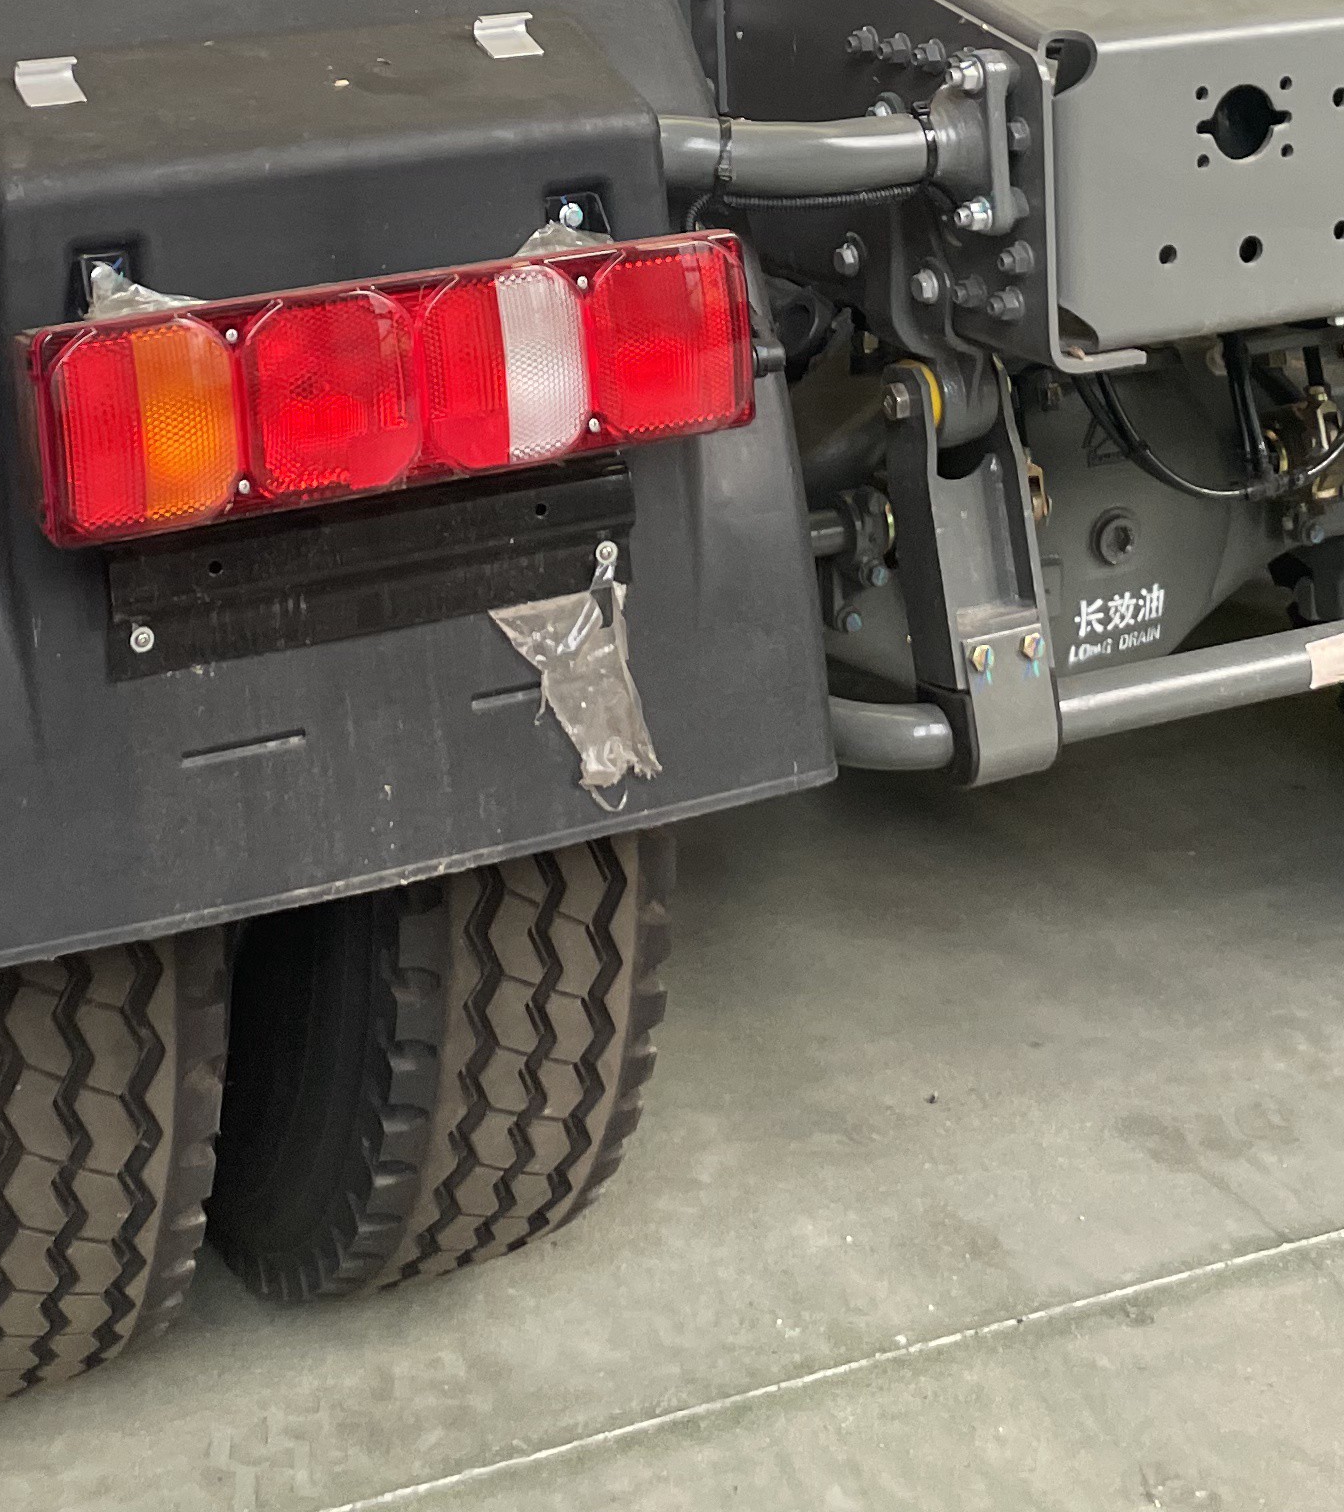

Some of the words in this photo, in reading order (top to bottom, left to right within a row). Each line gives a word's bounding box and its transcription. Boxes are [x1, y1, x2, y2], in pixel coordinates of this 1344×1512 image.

[1074, 582, 1165, 638] 长效油
[1118, 624, 1161, 651] DRAIN
